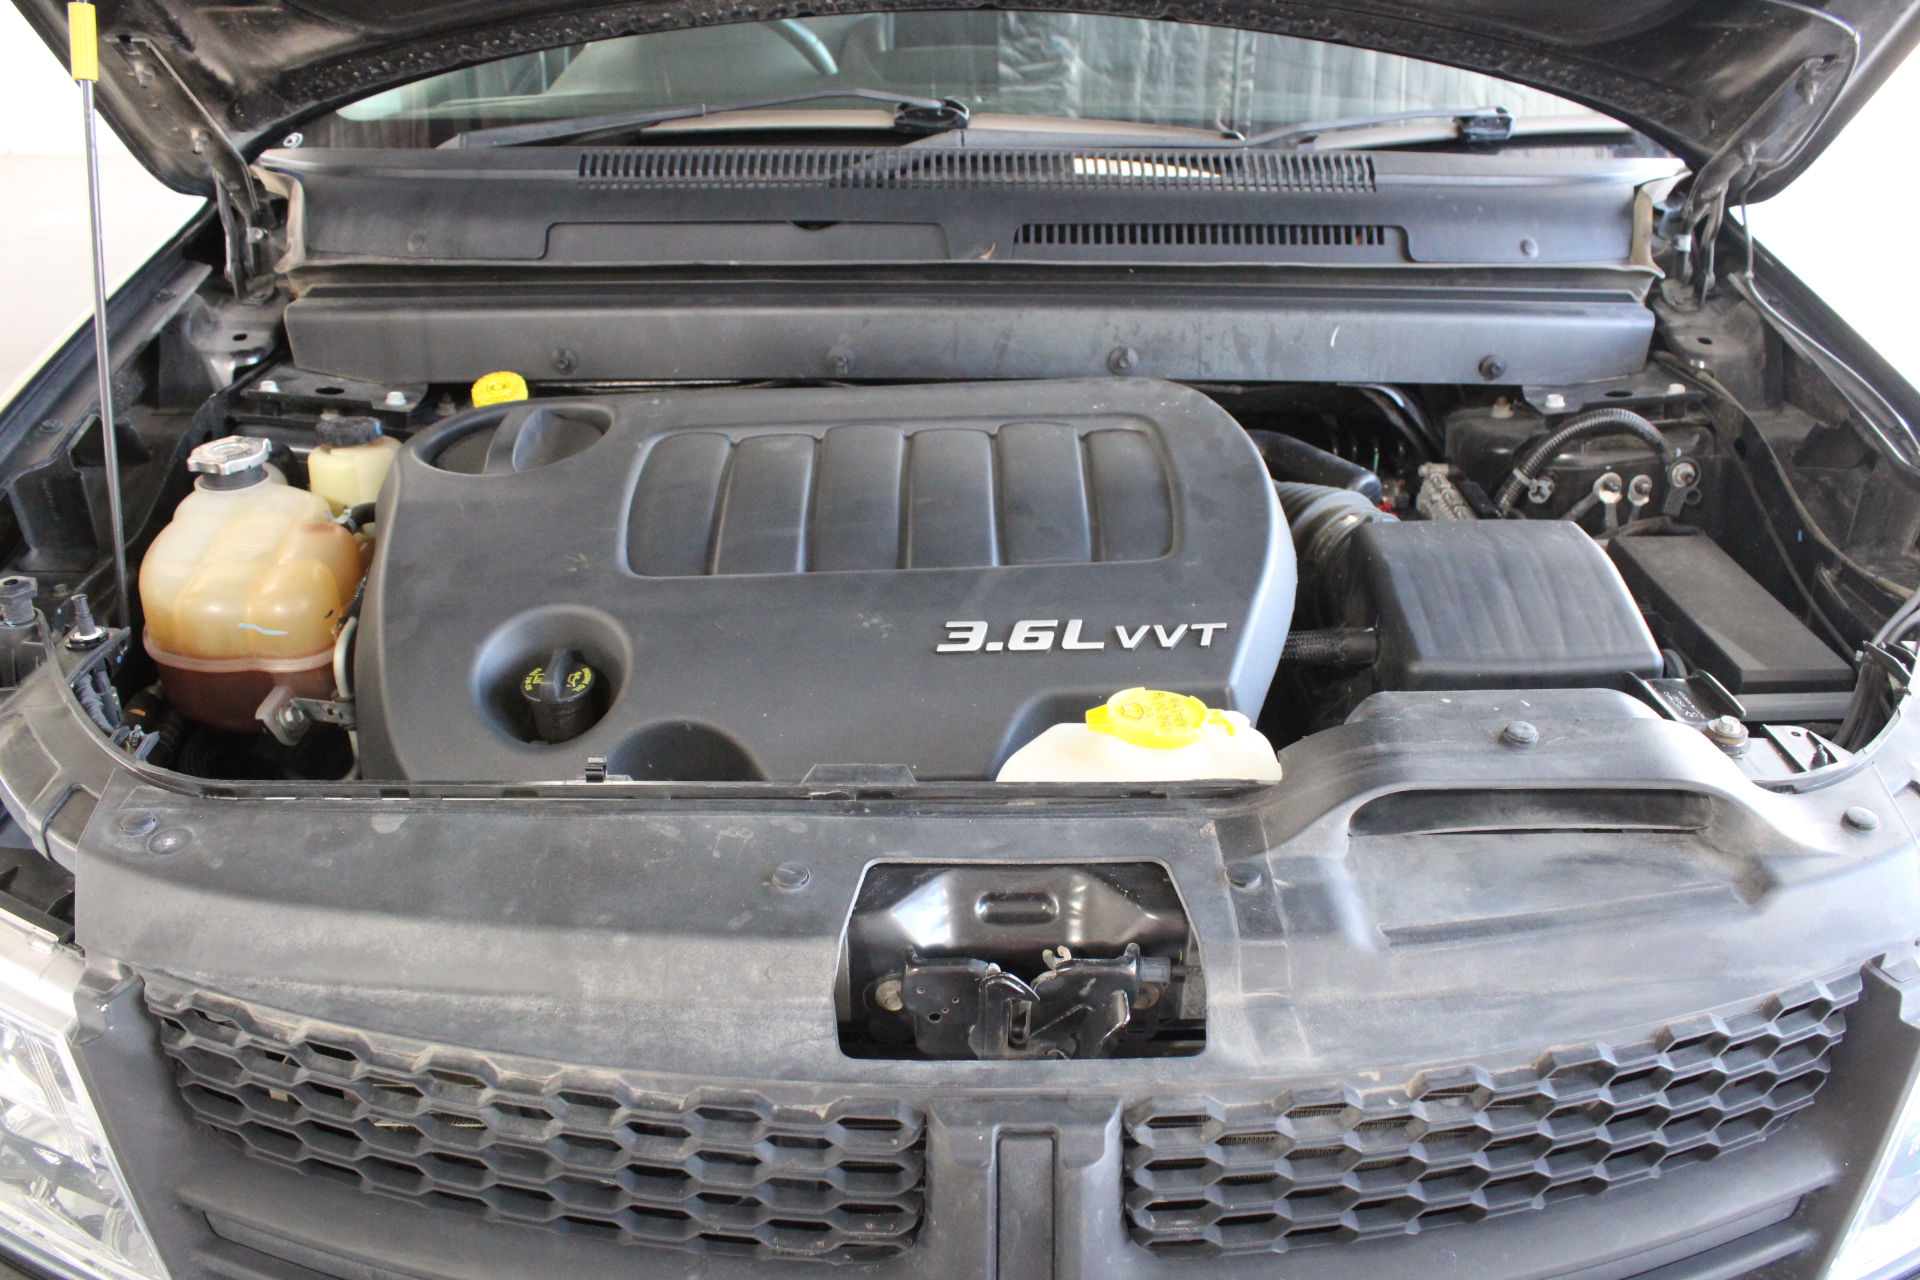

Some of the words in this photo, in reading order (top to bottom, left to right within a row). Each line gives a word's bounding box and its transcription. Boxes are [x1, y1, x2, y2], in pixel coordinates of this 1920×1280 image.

[936, 619, 1105, 652] 3.6L
[1115, 622, 1227, 650] VVT
[572, 684, 586, 692] OIL
[1170, 698, 1189, 727] WASHER
